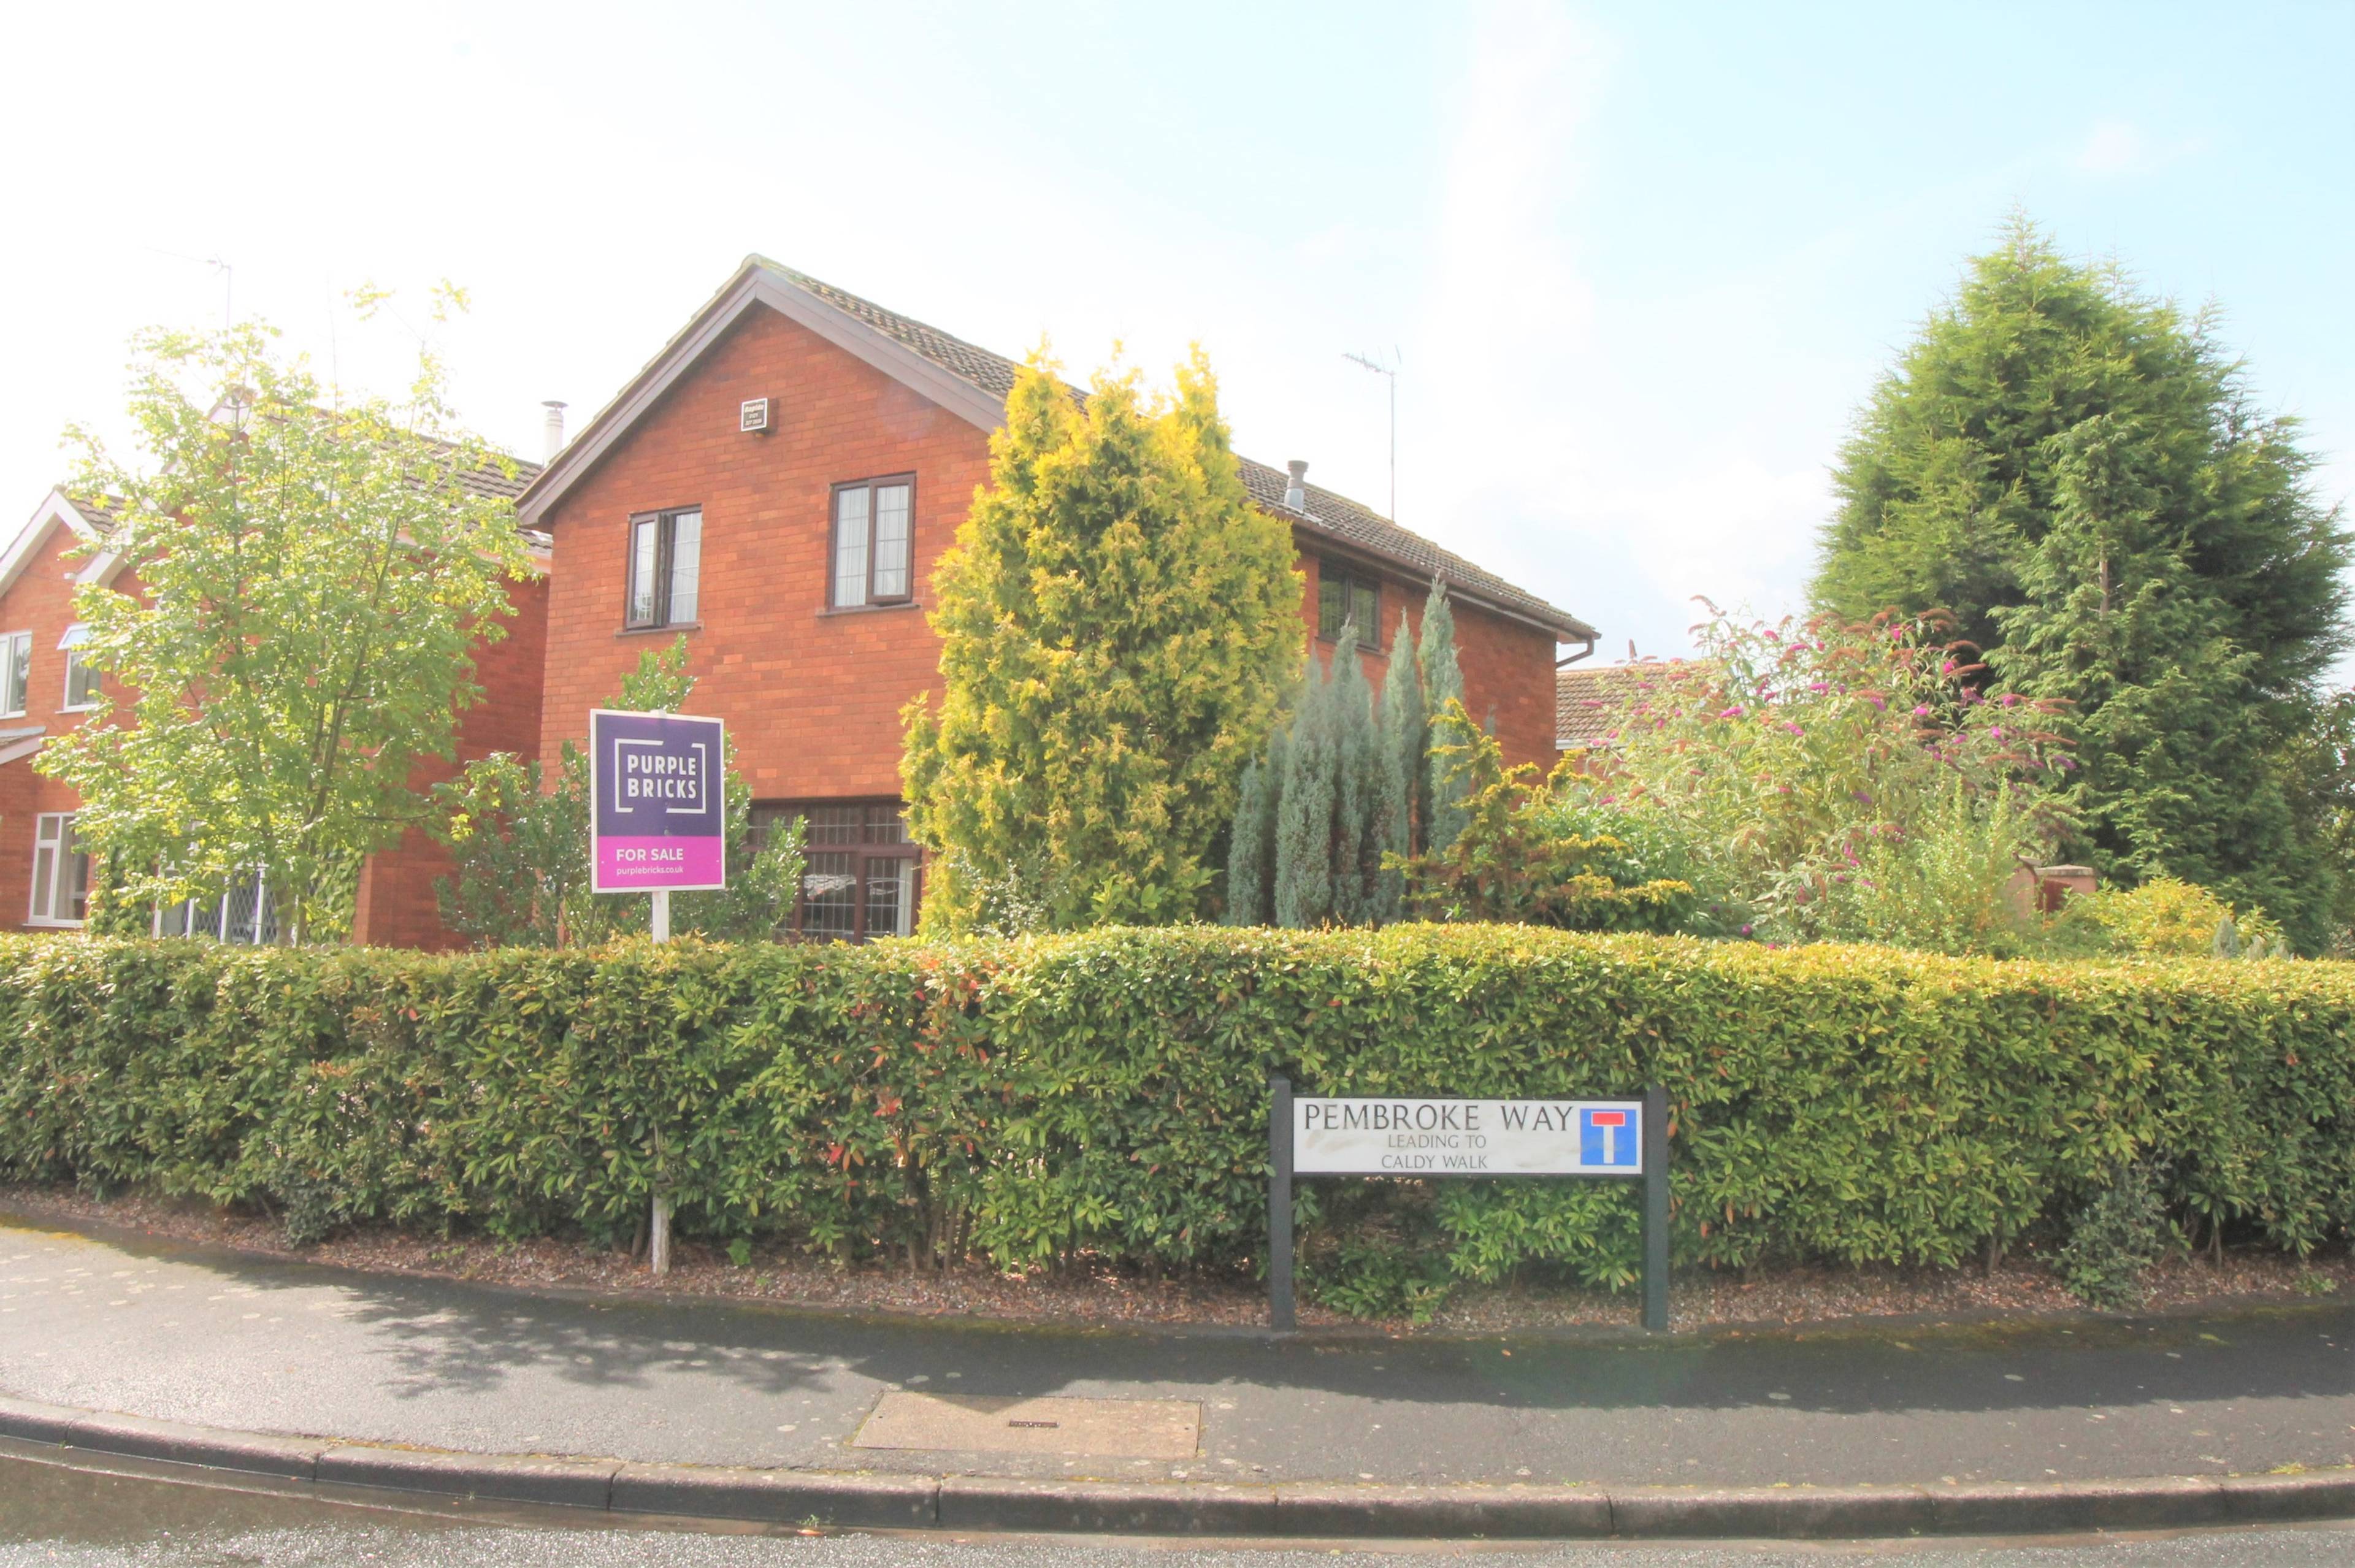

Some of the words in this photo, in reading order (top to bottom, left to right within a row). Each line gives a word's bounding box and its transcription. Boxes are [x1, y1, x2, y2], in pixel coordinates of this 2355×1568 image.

[627, 754, 696, 775] PURPLE
[627, 778, 696, 798] BRICKS
[616, 849, 646, 861] FOR
[651, 848, 684, 860] SALE
[616, 865, 684, 876] purplebricks.co.uk
[1304, 1103, 1480, 1131] PEMBROKE
[1501, 1105, 1573, 1131] WAY
[1388, 1134, 1459, 1149] LEADING
[1465, 1134, 1487, 1148] TO
[1381, 1155, 1435, 1168] CALDY
[1442, 1155, 1487, 1169] WALK
